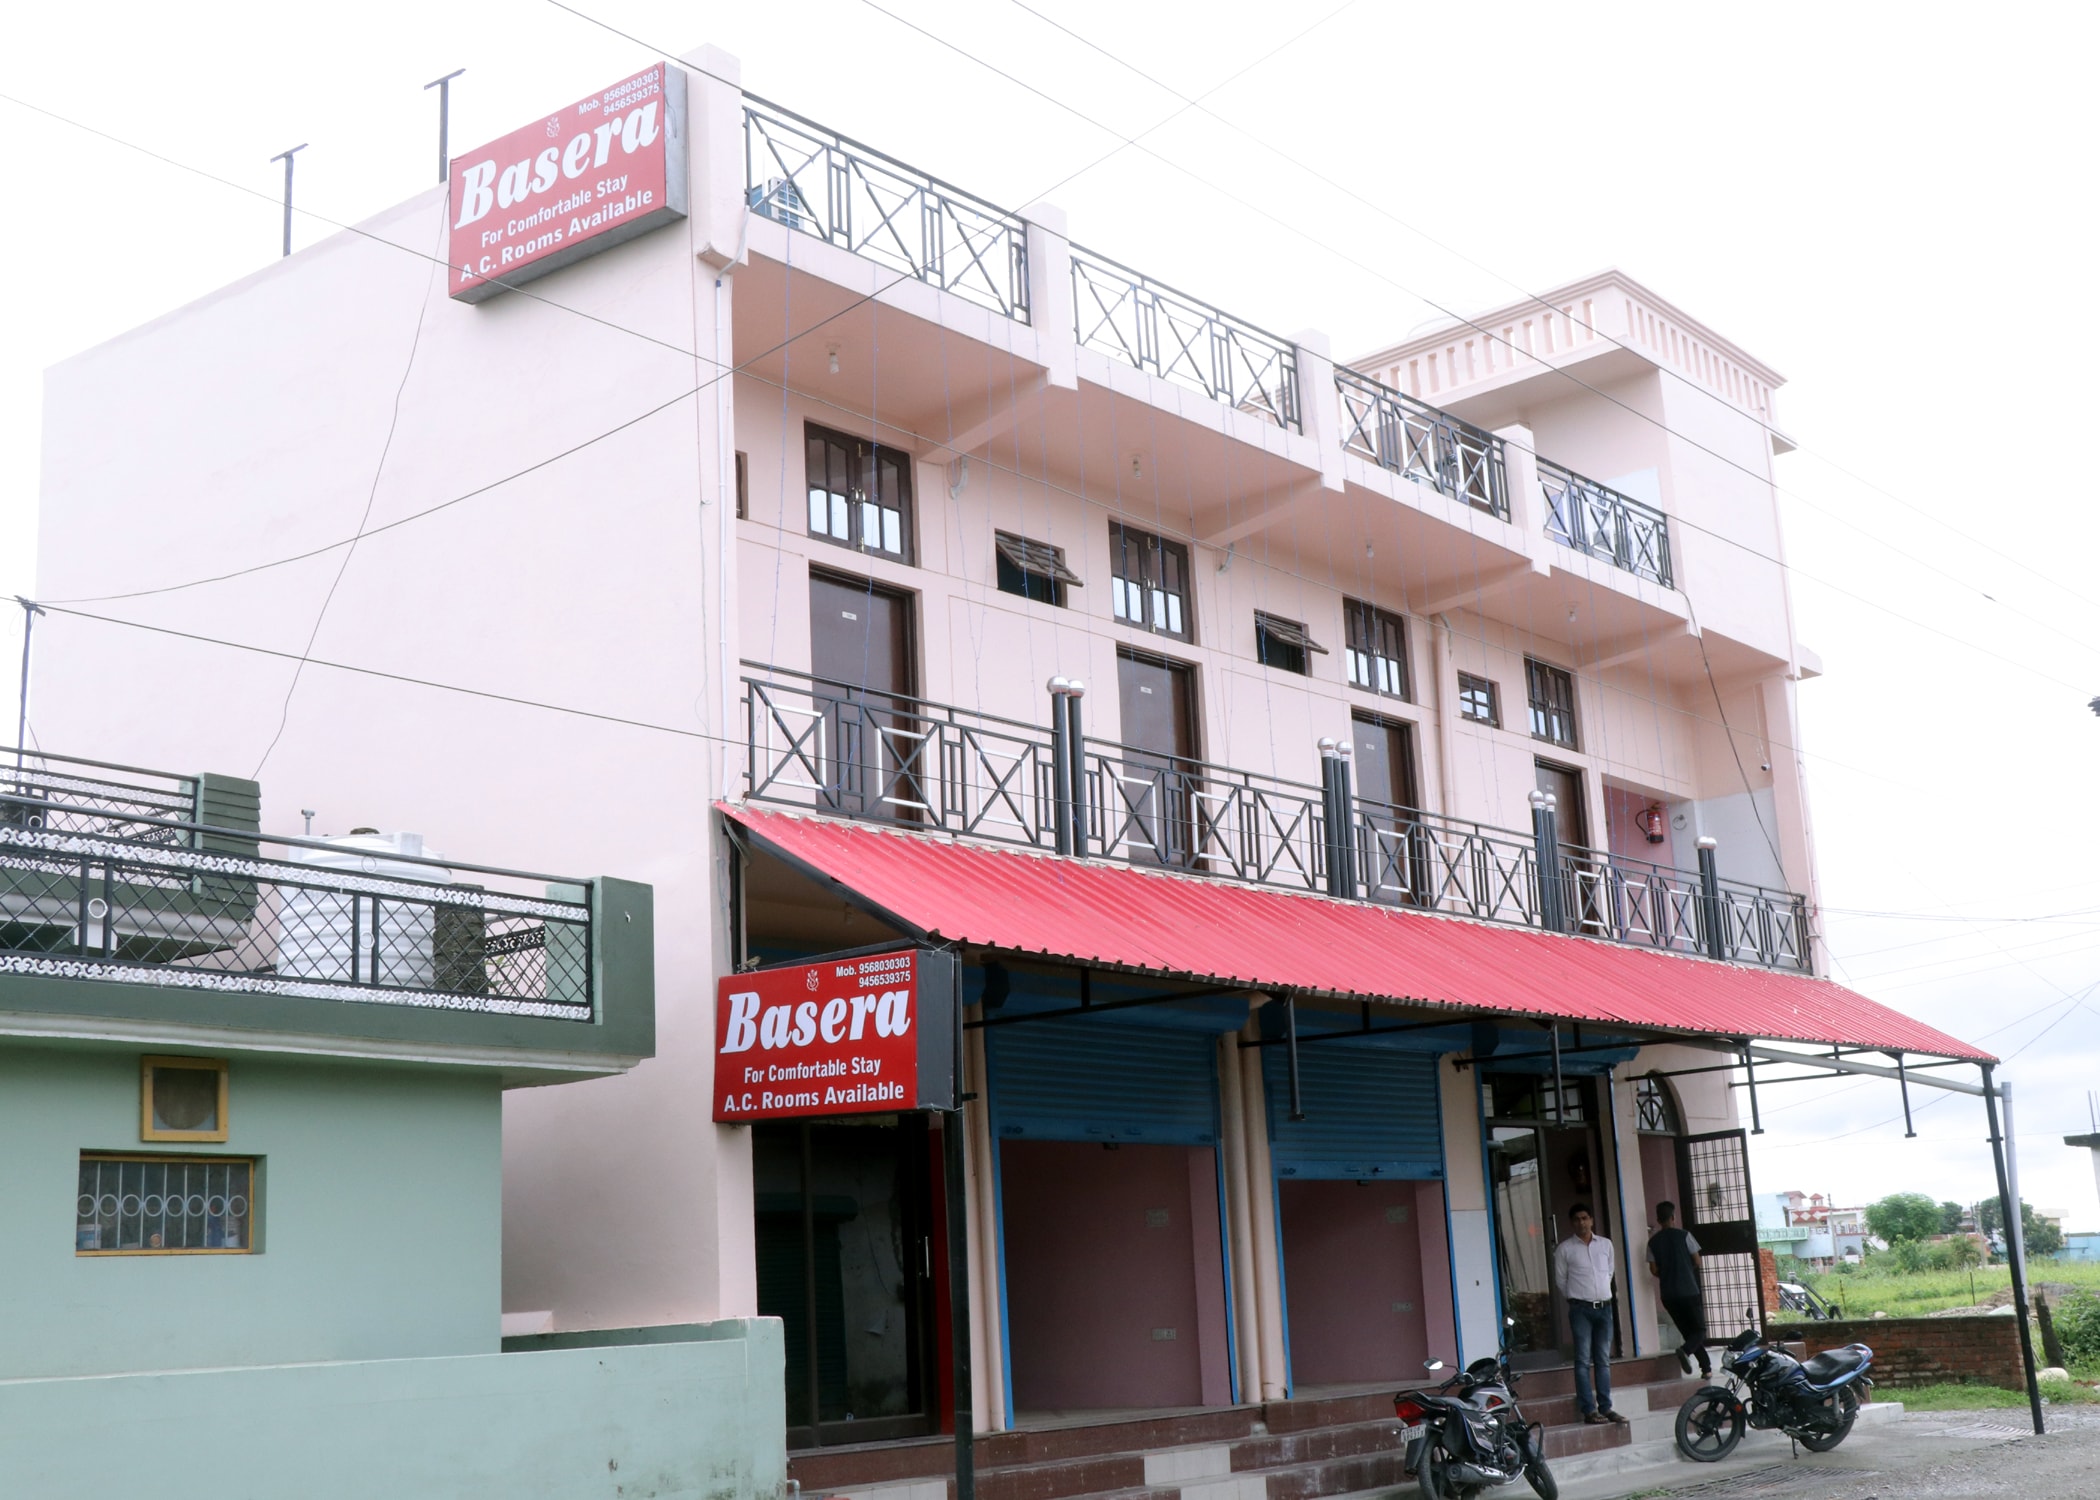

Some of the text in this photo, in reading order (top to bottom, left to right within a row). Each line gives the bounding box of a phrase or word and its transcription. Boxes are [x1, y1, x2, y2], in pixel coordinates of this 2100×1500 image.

[578, 70, 660, 115] Mob. 9568030303
[603, 83, 660, 116] 9456539375
[454, 100, 660, 230] Basera
[481, 174, 629, 248] For Comfortable Stay
[460, 190, 653, 282] A.C. Rooms Available
[835, 956, 911, 977] Mob. 9568030303
[859, 971, 911, 988] 9456539375
[719, 990, 911, 1054] Basera
[744, 1057, 882, 1084] For Comfortable Stay
[723, 1081, 904, 1113] A.C. Rooms Available
